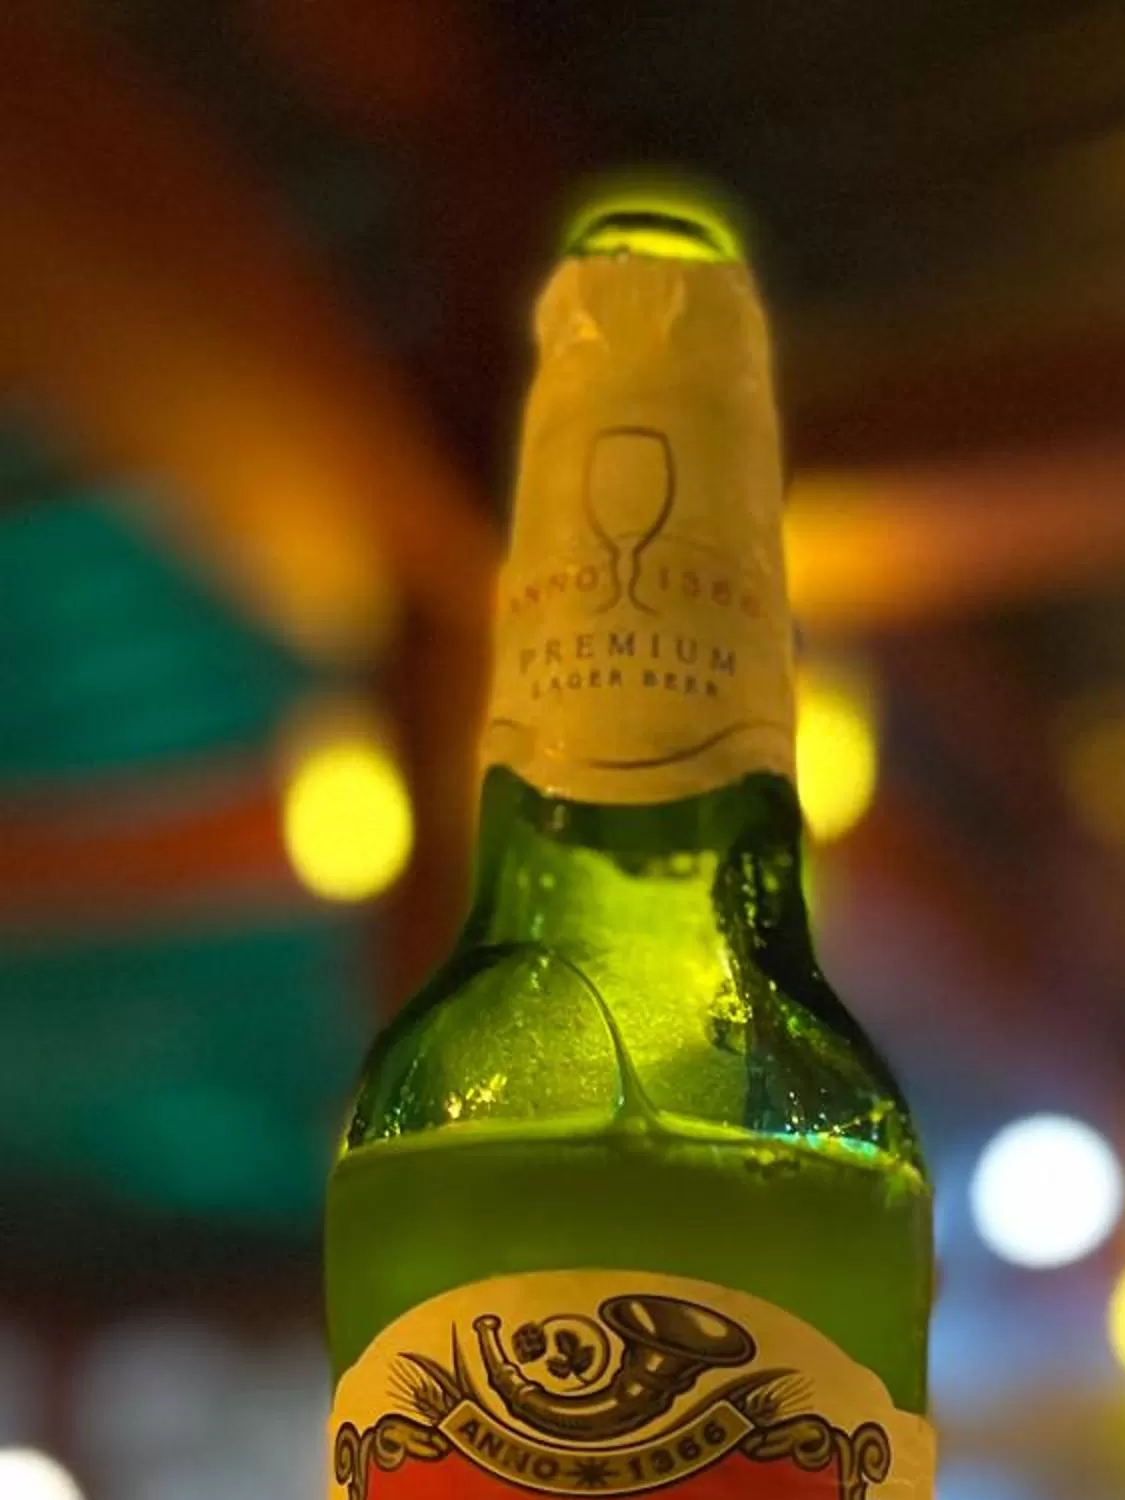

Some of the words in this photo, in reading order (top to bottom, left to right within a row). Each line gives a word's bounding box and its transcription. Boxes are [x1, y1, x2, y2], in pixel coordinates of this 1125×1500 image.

[519, 631, 736, 676] PREMIUM
[531, 669, 622, 700] LAGER
[643, 669, 718, 697] BEER
[459, 1418, 560, 1480] ANNO
[627, 1419, 726, 1481] 1366
